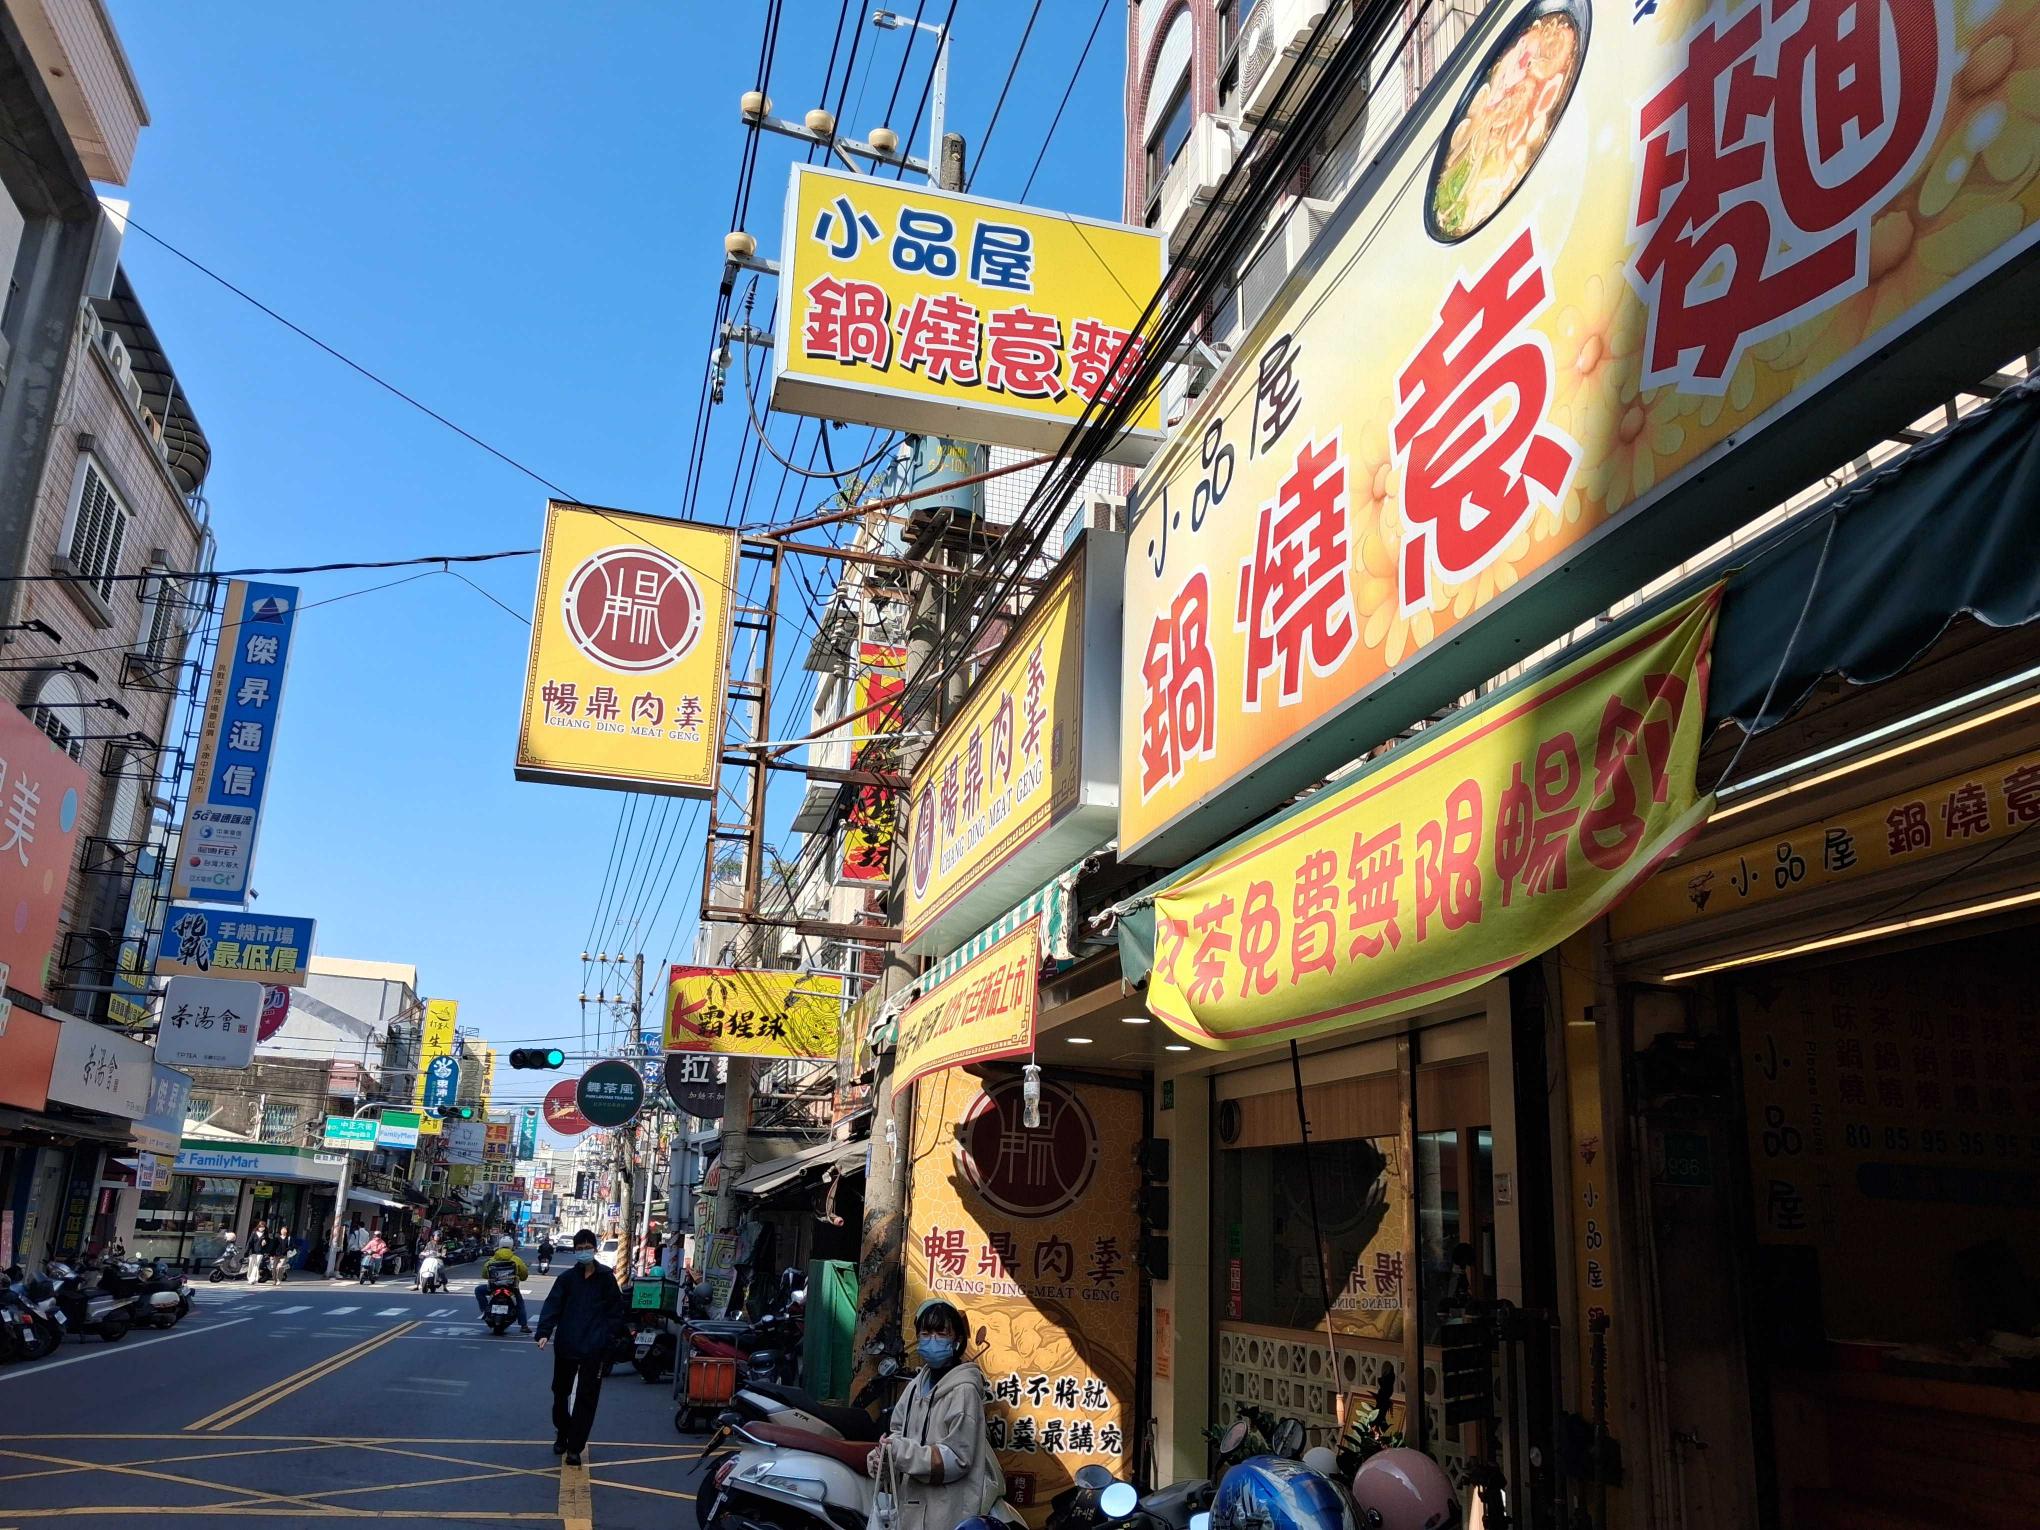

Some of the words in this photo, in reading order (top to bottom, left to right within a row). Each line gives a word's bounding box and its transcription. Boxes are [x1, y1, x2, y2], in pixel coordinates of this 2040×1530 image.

[815, 198, 1032, 291] 小品屋
[805, 276, 1147, 404] 鍋燒意麵
[1149, 333, 1302, 578] 小品屋
[223, 633, 279, 796] 傑昇通信
[541, 680, 704, 732] 暢鼎肉羹
[549, 716, 591, 730] CHANG
[596, 721, 625, 734] DING
[631, 726, 664, 739] MEAT
[668, 730, 700, 743] GENG
[0, 757, 40, 868] 美
[966, 822, 986, 849] DING
[988, 788, 1013, 832] MEAT
[1016, 768, 1043, 803] GENG
[1730, 828, 1858, 898] 小品屋
[172, 912, 214, 973] 挑戰
[211, 941, 299, 975] 最低價
[218, 922, 296, 945] 手機市場
[171, 1003, 241, 1033] 茶湯會
[189, 1153, 260, 1169] FamilyMart
[923, 1226, 1125, 1289] 暢鼎肉羹
[1583, 1182, 1603, 1288] 小品屋
[935, 1279, 984, 1293] CHANG
[992, 1282, 1026, 1296] DING
[1034, 1286, 1074, 1299] MEAT
[1082, 1289, 1120, 1302] GENG
[987, 1417, 1122, 1454] 肉羹最講究
